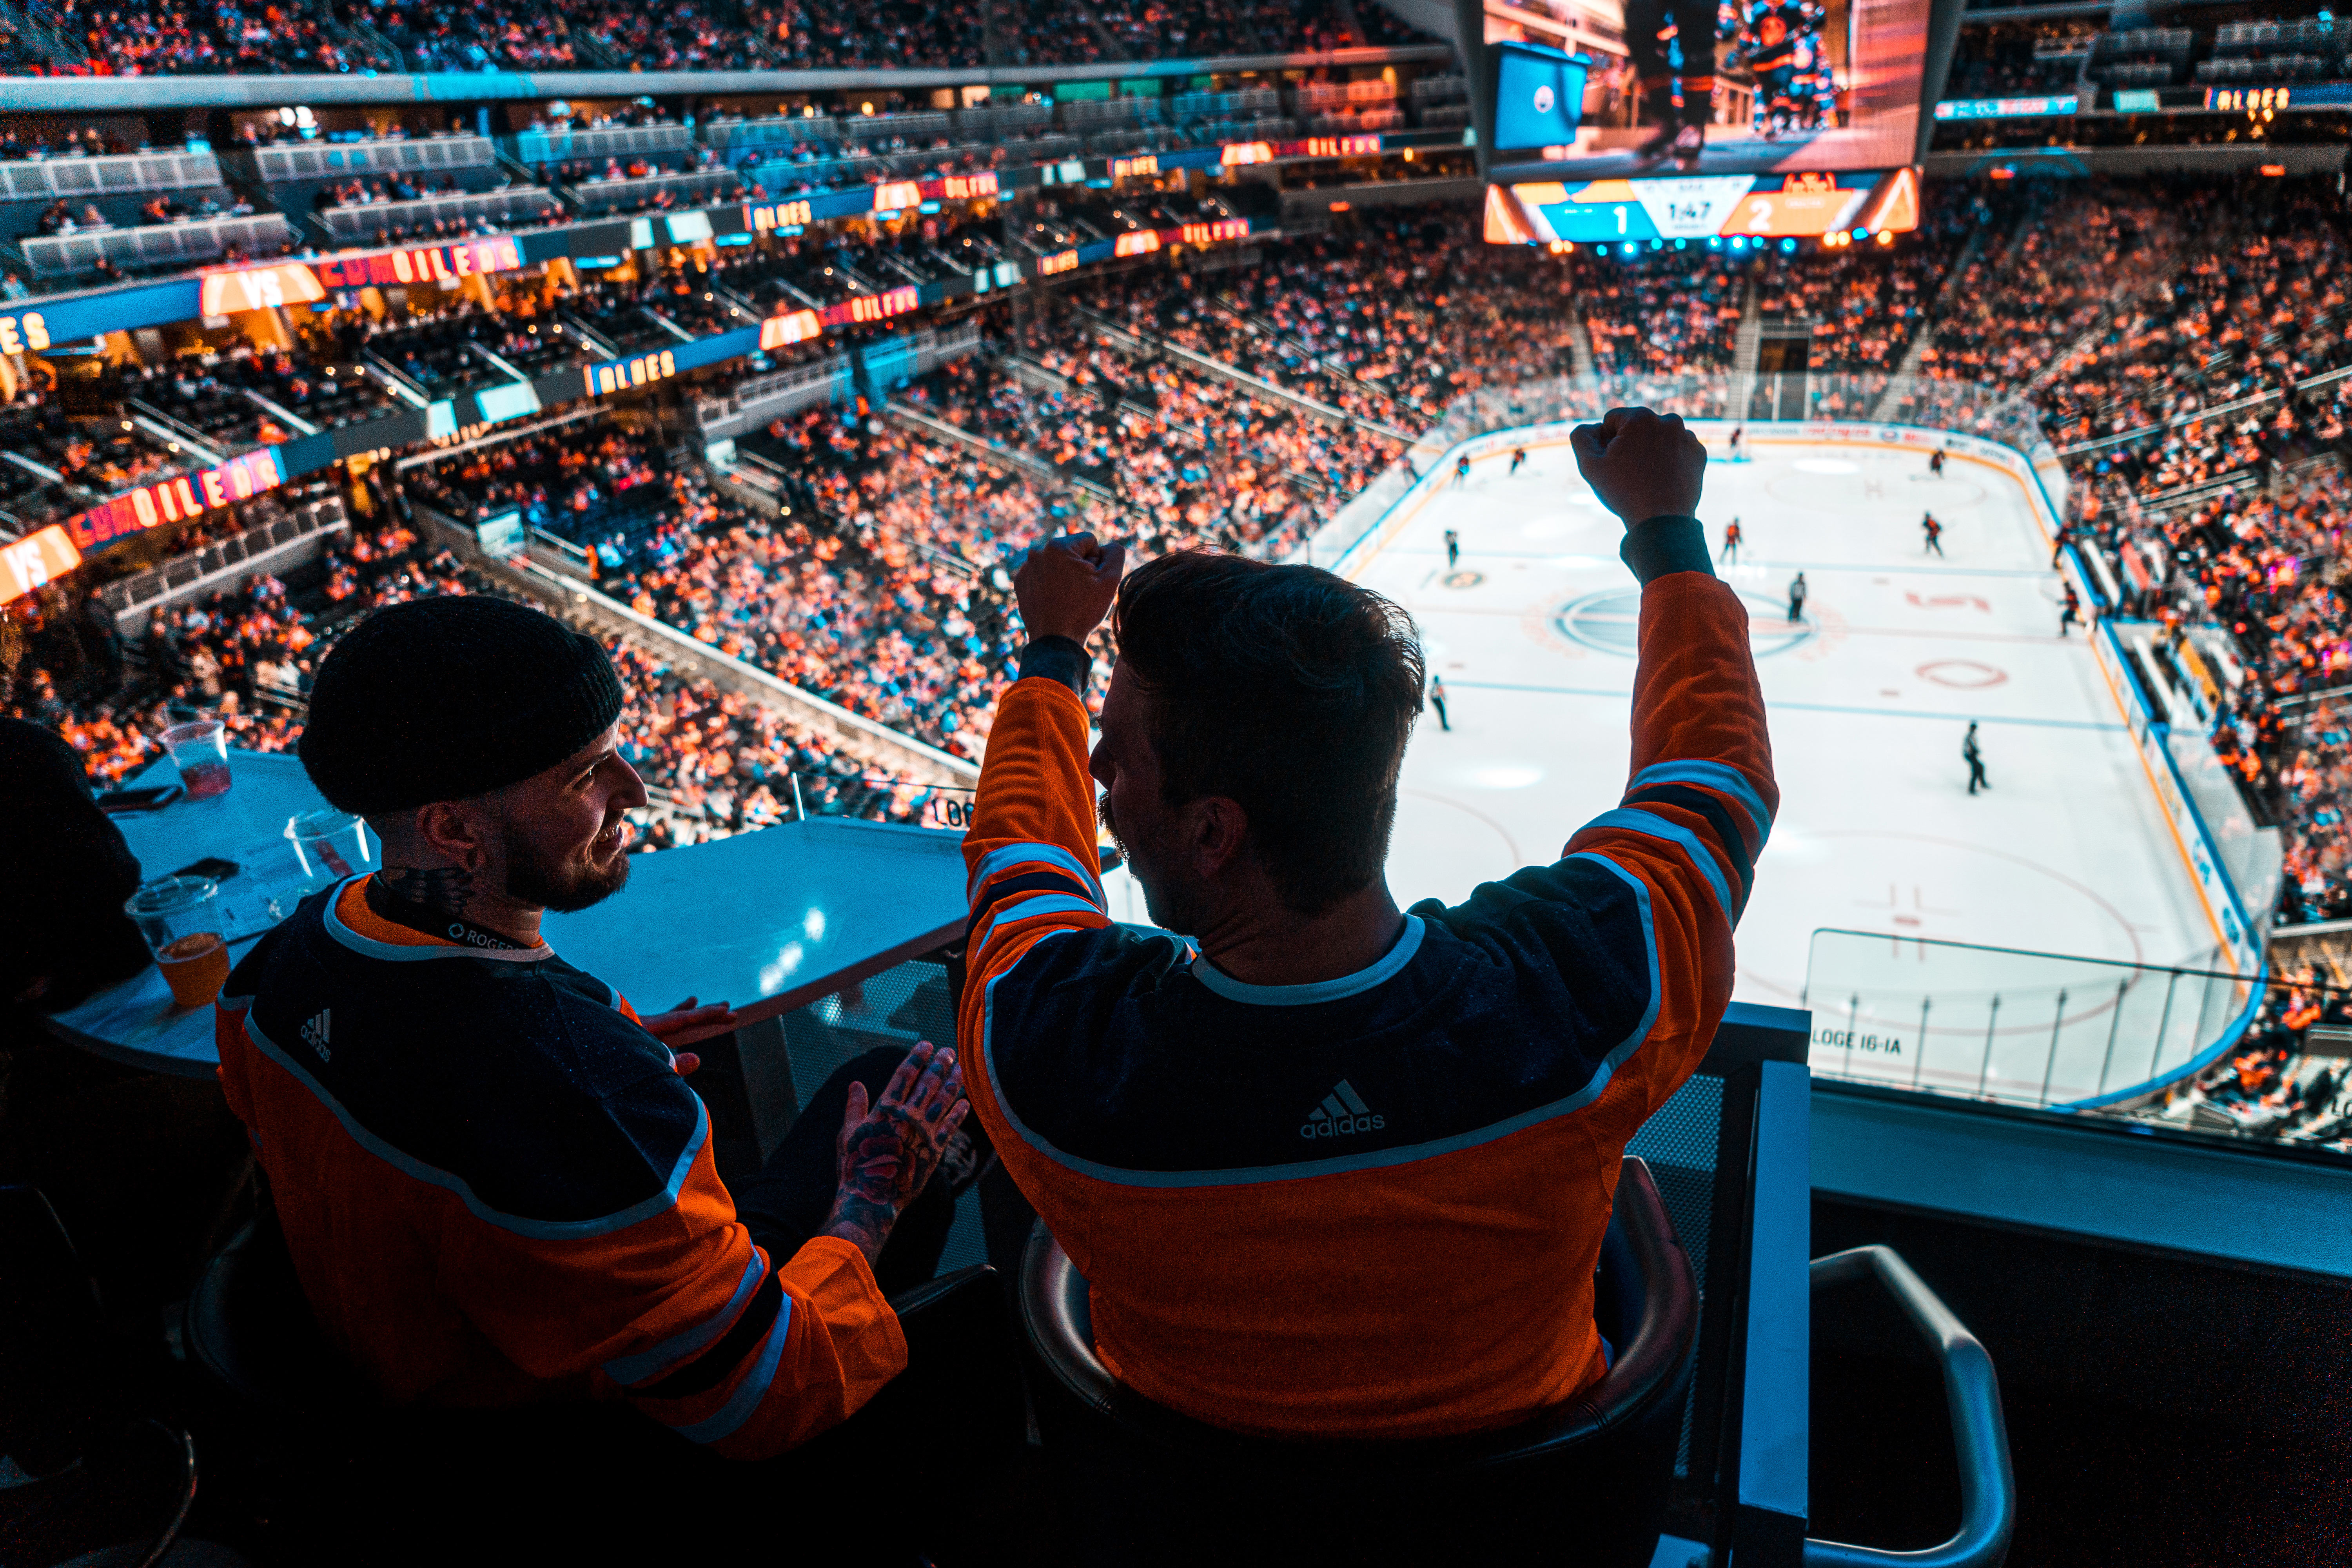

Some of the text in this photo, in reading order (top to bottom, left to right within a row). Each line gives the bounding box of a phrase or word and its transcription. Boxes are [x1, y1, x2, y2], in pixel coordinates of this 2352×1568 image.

[1613, 205, 1627, 234] 1
[1748, 199, 1772, 232] 2
[237, 270, 284, 310] VS
[391, 243, 521, 283] OILERS
[4, 540, 49, 593] VS
[131, 457, 280, 528] OILERS
[467, 929, 519, 950] ROGE
[300, 1025, 331, 1063] adidas
[1812, 1027, 1855, 1049] LOGE
[1300, 1114, 1386, 1139] adidas
